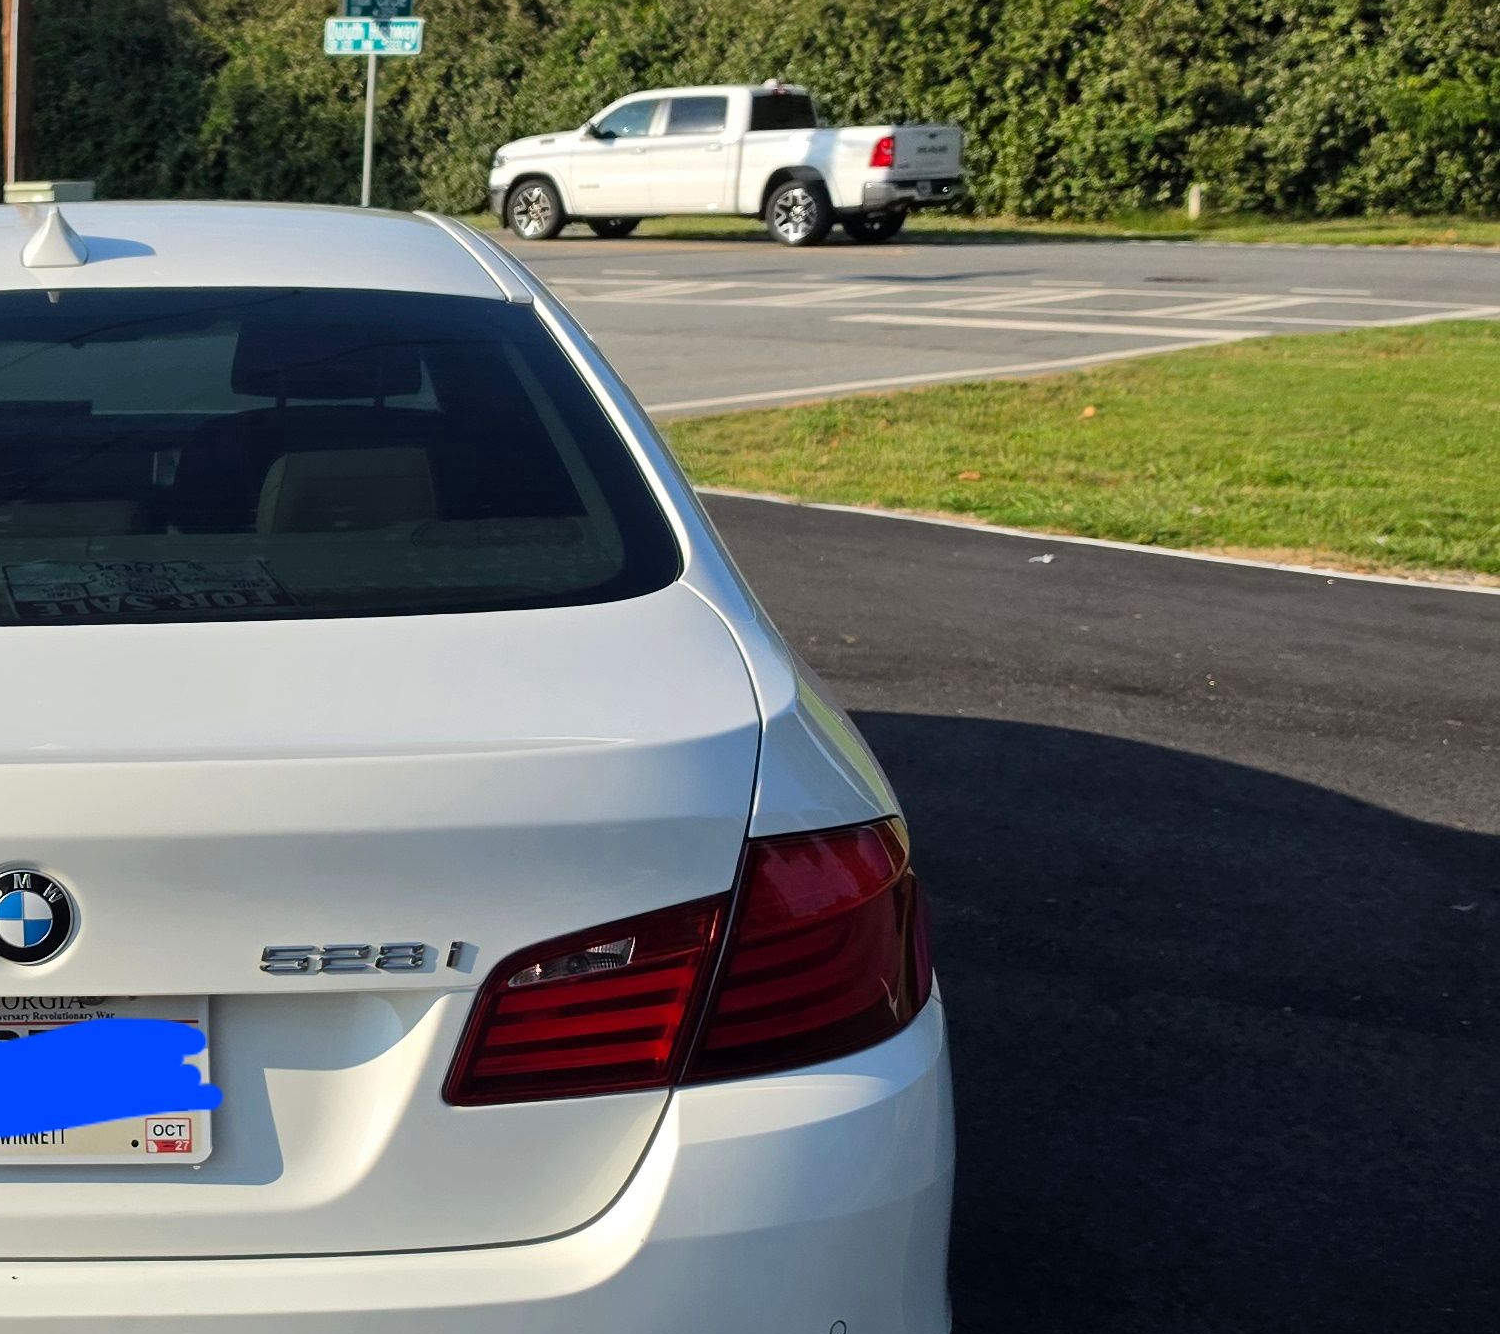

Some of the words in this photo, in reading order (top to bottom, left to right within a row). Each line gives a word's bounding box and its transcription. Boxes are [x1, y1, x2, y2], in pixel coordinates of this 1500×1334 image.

[259, 940, 464, 974] 528i
[32, 1012, 93, 1021] Revolutionary
[96, 1011, 116, 1020] War
[152, 1124, 186, 1137] OCT
[174, 1140, 190, 1151] 27
